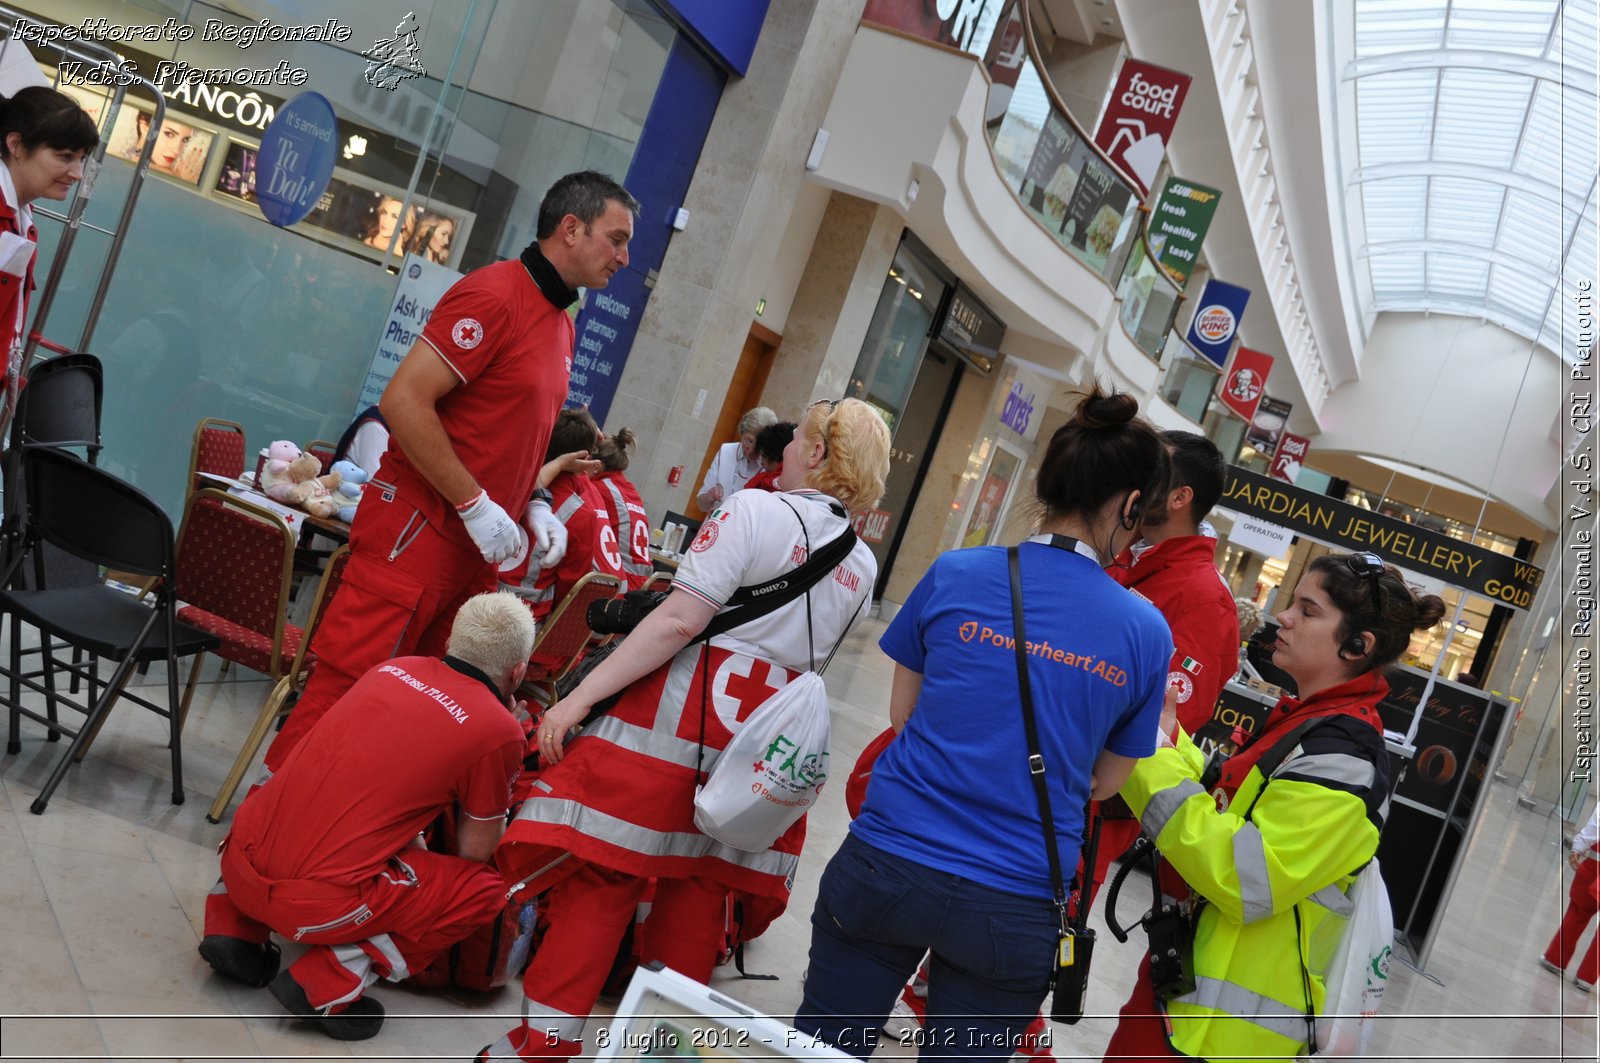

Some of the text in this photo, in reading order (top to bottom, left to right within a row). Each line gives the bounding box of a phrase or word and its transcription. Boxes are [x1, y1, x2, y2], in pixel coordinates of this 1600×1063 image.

[1129, 72, 1179, 102] food
[1121, 92, 1174, 119] court
[301, 117, 332, 142] arrived
[278, 137, 299, 172] Ta
[266, 166, 316, 206] Dah!
[1169, 183, 1216, 203] SUBWAY
[1161, 201, 1187, 217] fresh
[1161, 221, 1197, 241] healthy
[1169, 245, 1194, 261] tasty
[394, 294, 417, 318] Ask
[595, 292, 631, 319] welcome
[951, 299, 983, 335] EXHIBIT
[585, 317, 618, 342] pharmacy
[1200, 320, 1231, 332] KING
[1201, 314, 1231, 324] BURGER
[580, 334, 604, 356] beauty
[574, 350, 592, 371] baby
[596, 361, 613, 376] child
[863, 513, 890, 540] SALE
[1243, 523, 1284, 541] OPERATION
[1338, 517, 1482, 577] JEWELLERY
[752, 580, 789, 597] Canon
[1484, 579, 1530, 607] GOLD
[979, 626, 1127, 687] Powerheart AED
[428, 687, 469, 724] ITALIANA
